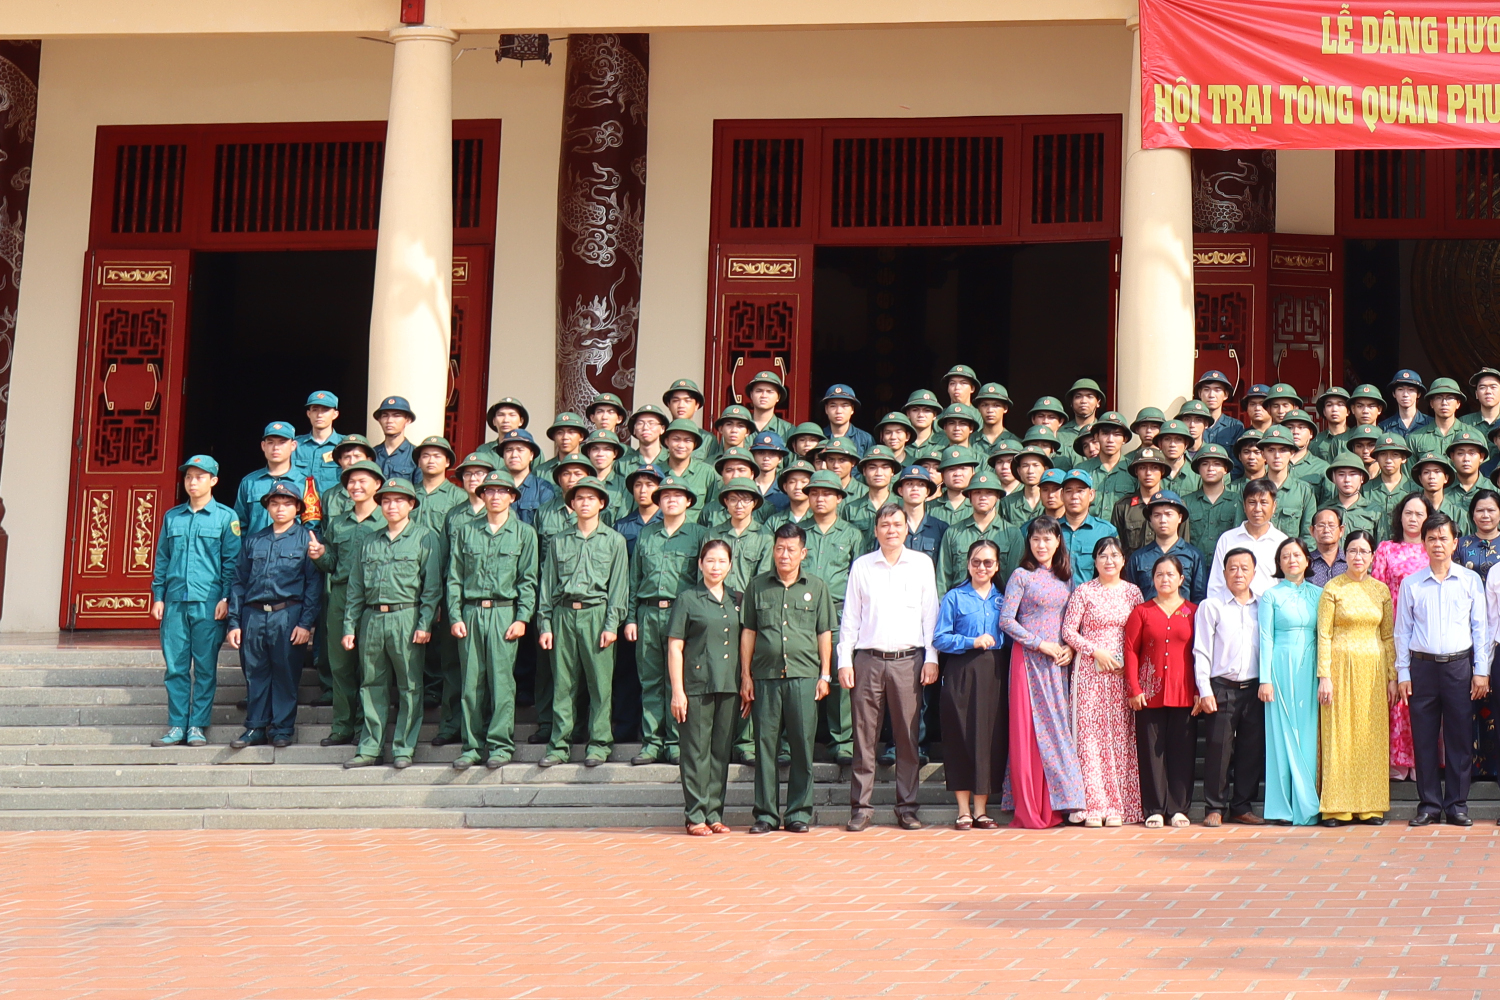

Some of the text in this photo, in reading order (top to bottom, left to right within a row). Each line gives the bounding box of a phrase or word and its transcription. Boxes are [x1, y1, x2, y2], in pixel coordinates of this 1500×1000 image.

[1320, 2, 1355, 55] LỄ
[1361, 9, 1440, 54] DÂNG
[1153, 75, 1201, 132] HỘI
[1206, 83, 1273, 132] TRẠI
[1279, 75, 1354, 125] TÒNG
[1360, 76, 1439, 133] QUÂN
